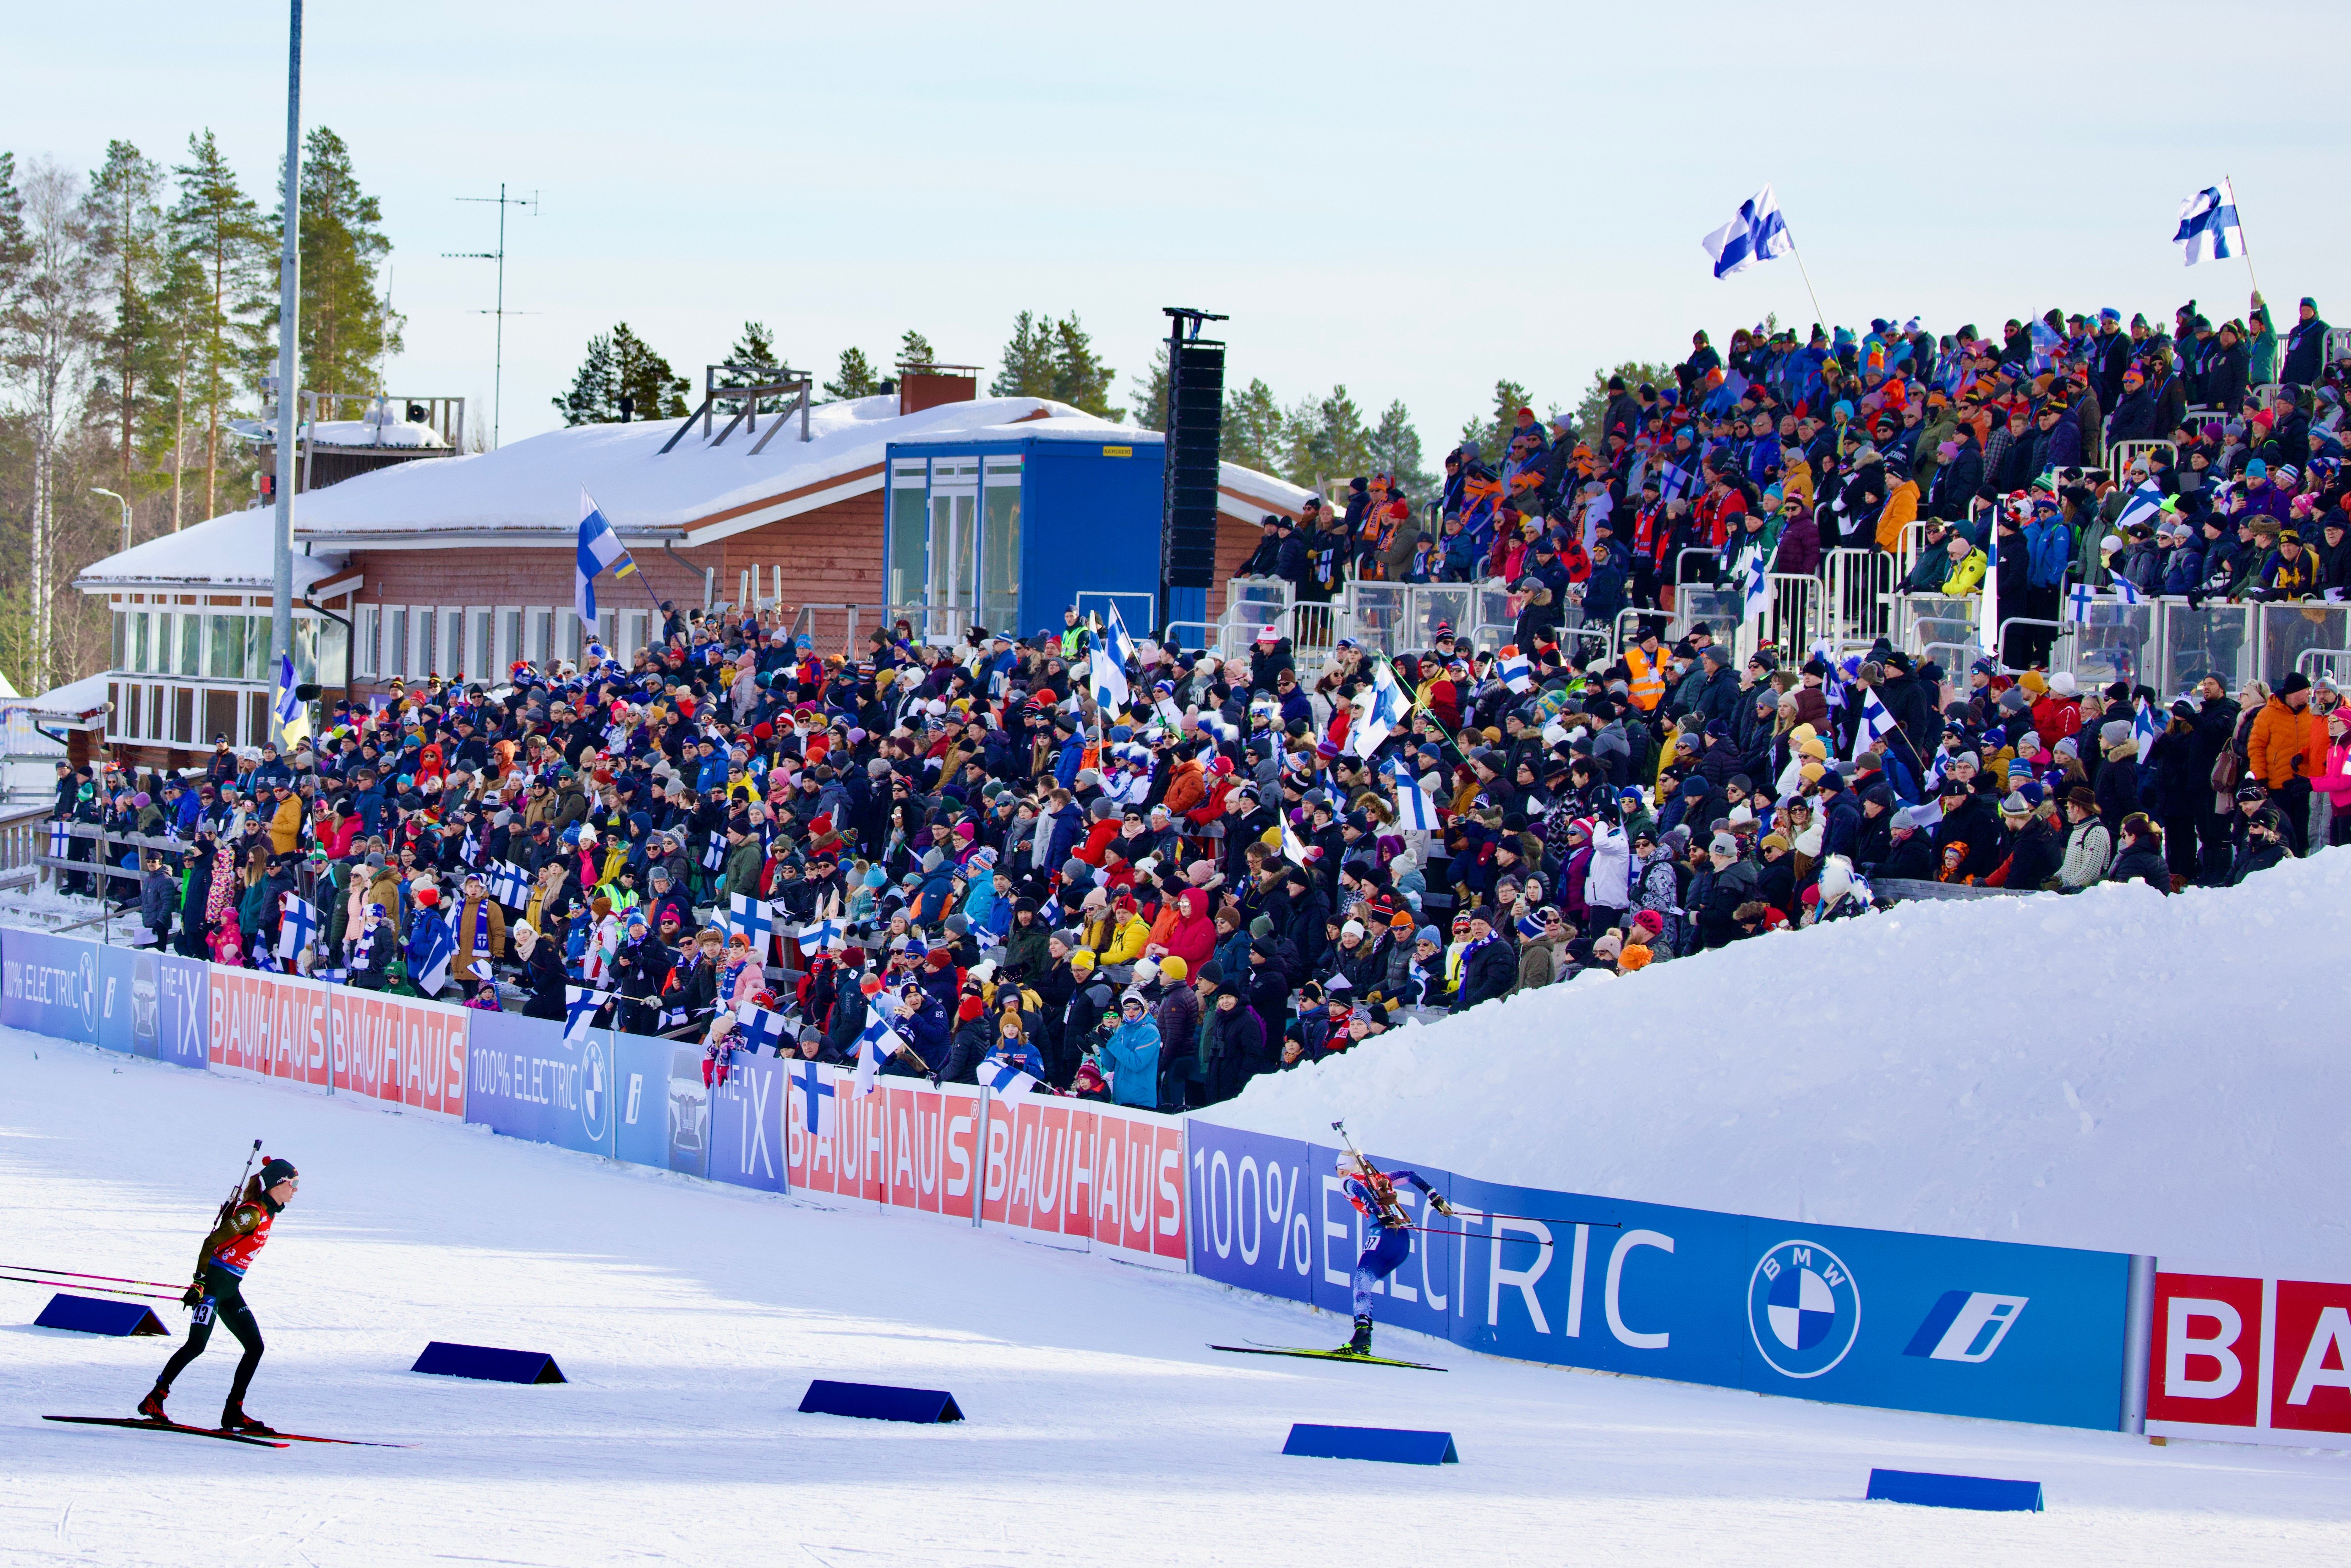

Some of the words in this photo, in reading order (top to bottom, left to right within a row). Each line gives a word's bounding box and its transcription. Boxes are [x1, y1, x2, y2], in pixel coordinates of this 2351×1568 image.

[4, 960, 22, 999] 100%
[26, 964, 79, 1009] ELECTRIC
[161, 966, 176, 997] THE
[672, 1007, 684, 1015] SUOMI
[473, 1047, 510, 1098] 100%
[514, 1055, 577, 1111] ELECTRIC
[230, 1219, 241, 1232] ATEX
[1194, 1146, 1311, 1276] 100%
[1365, 1237, 1377, 1249] 37
[1762, 1247, 1846, 1287] BMW
[194, 1305, 209, 1322] 43
